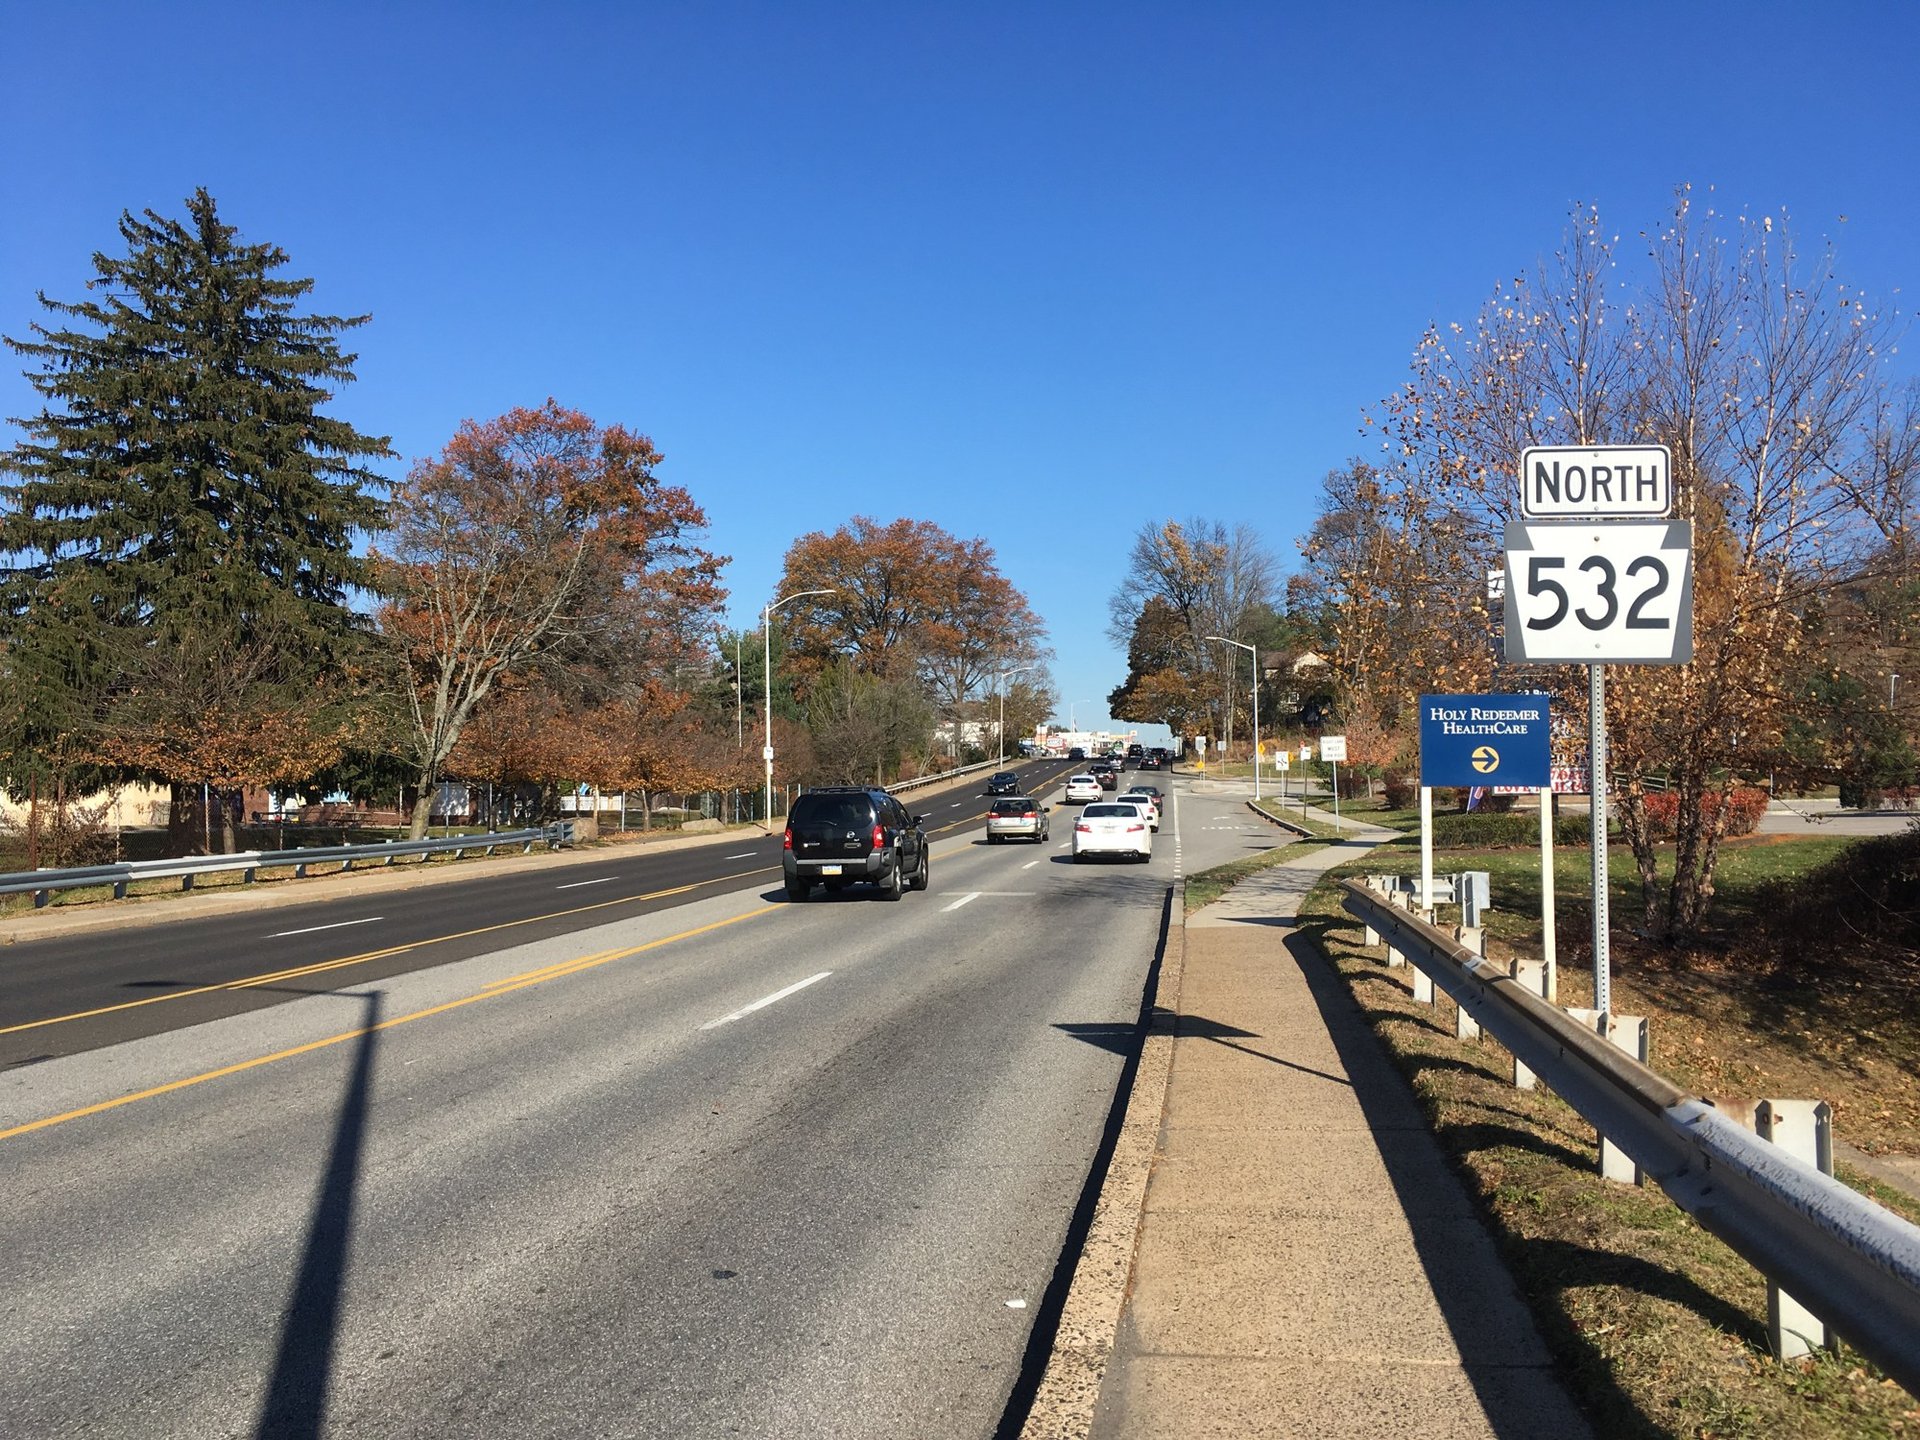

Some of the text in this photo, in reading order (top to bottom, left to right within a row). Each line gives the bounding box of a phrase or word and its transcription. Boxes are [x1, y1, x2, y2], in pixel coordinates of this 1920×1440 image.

[1535, 461, 1658, 503] NORTH
[1526, 555, 1670, 631] 532
[1430, 707, 1540, 721] HOLY REDEEMER
